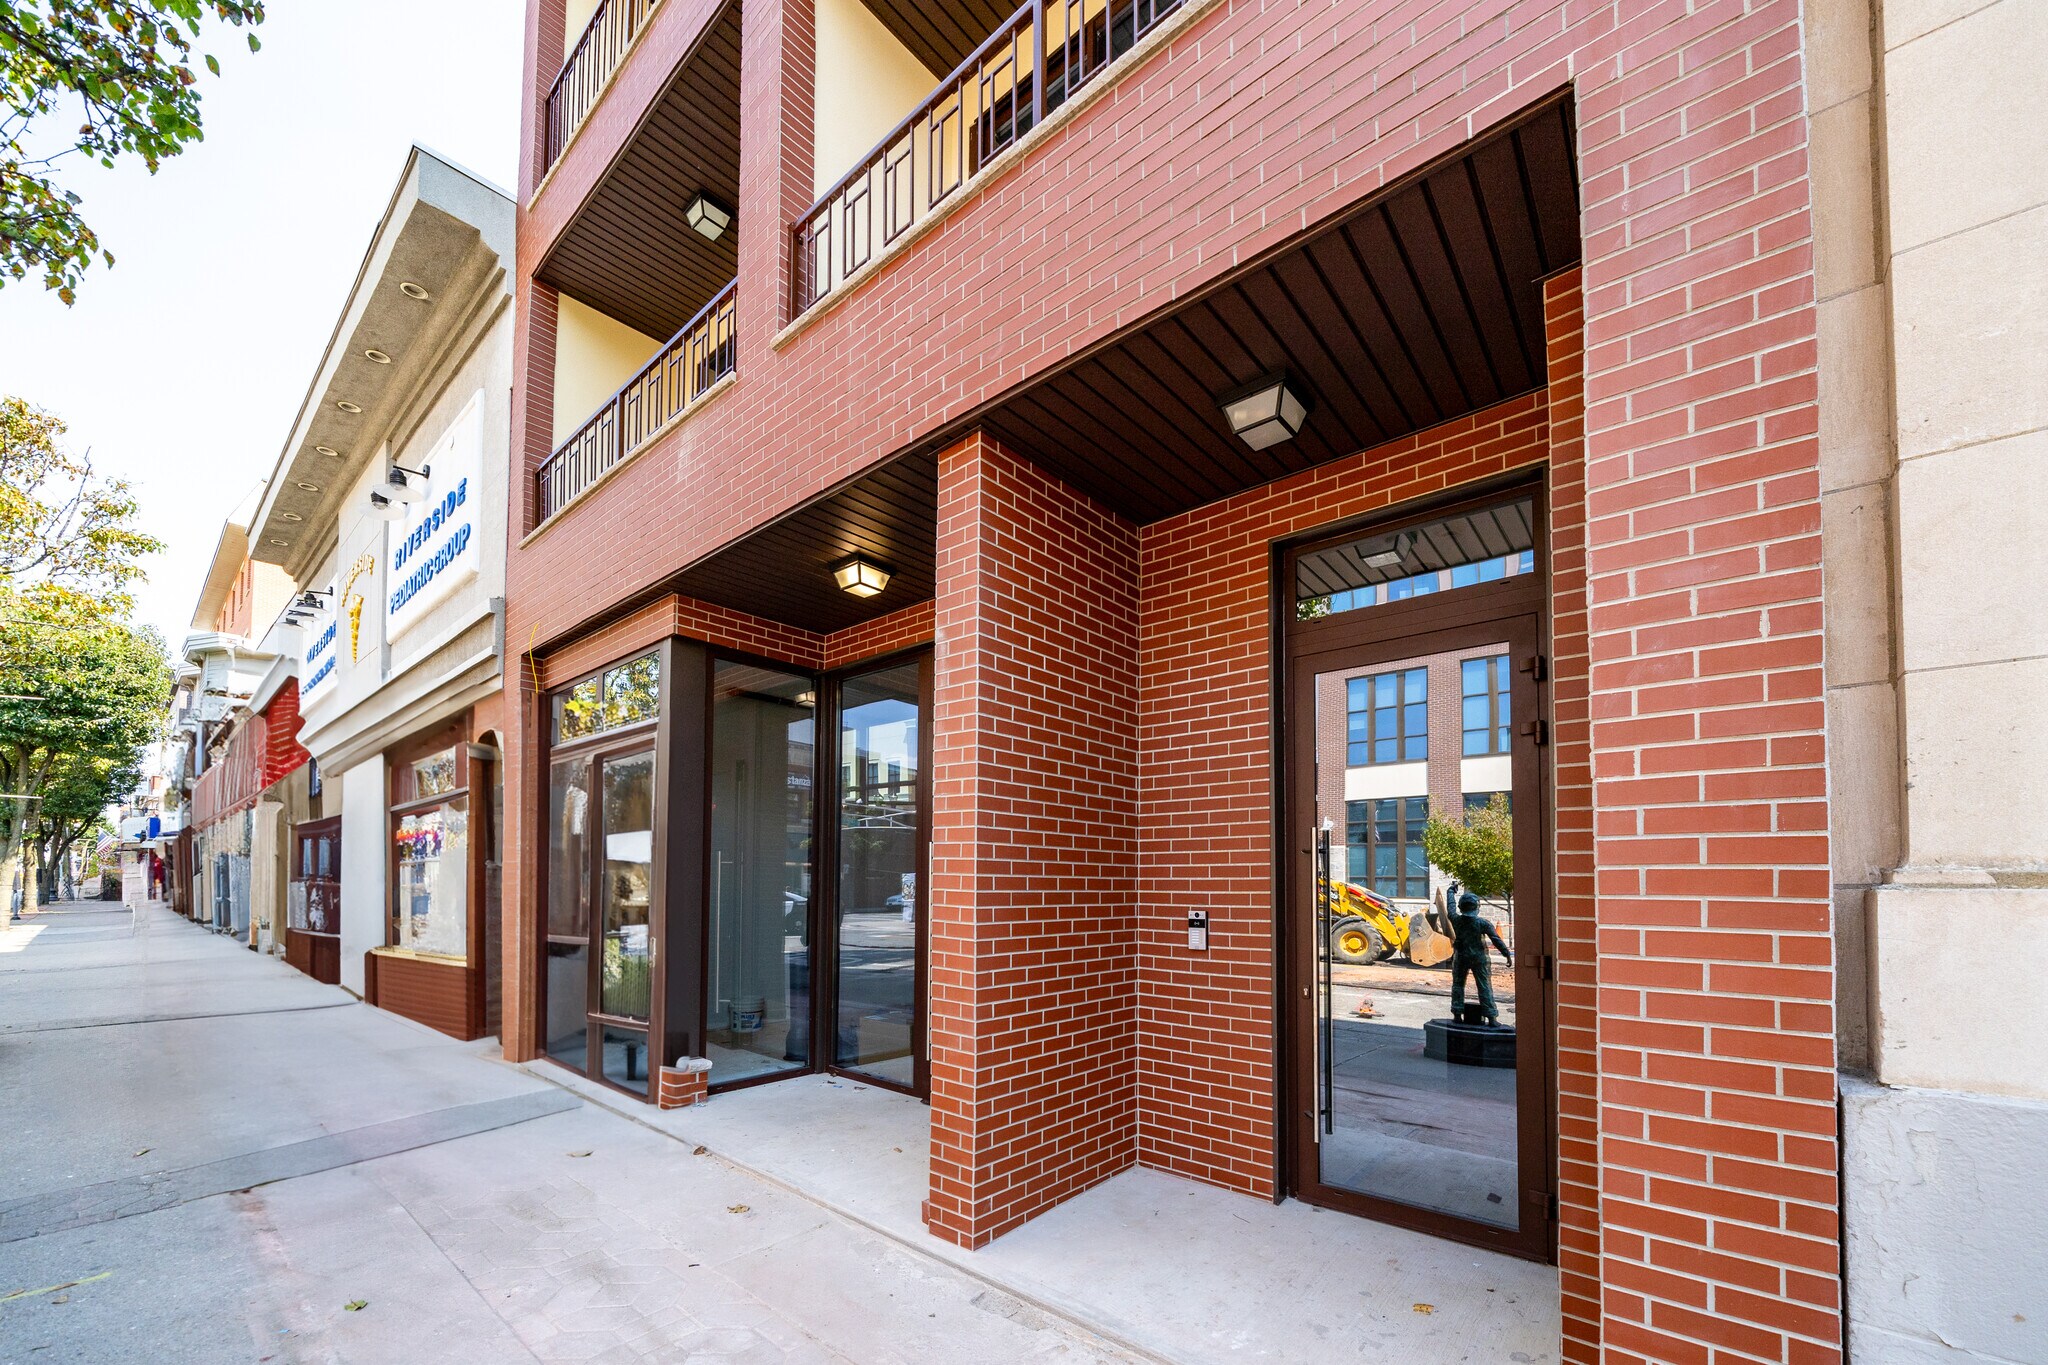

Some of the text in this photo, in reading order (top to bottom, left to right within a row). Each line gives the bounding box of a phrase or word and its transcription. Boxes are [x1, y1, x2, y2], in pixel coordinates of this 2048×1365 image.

[389, 522, 472, 615] PEDIATRIC GROUP
[394, 477, 468, 571] RIVERSIDE
